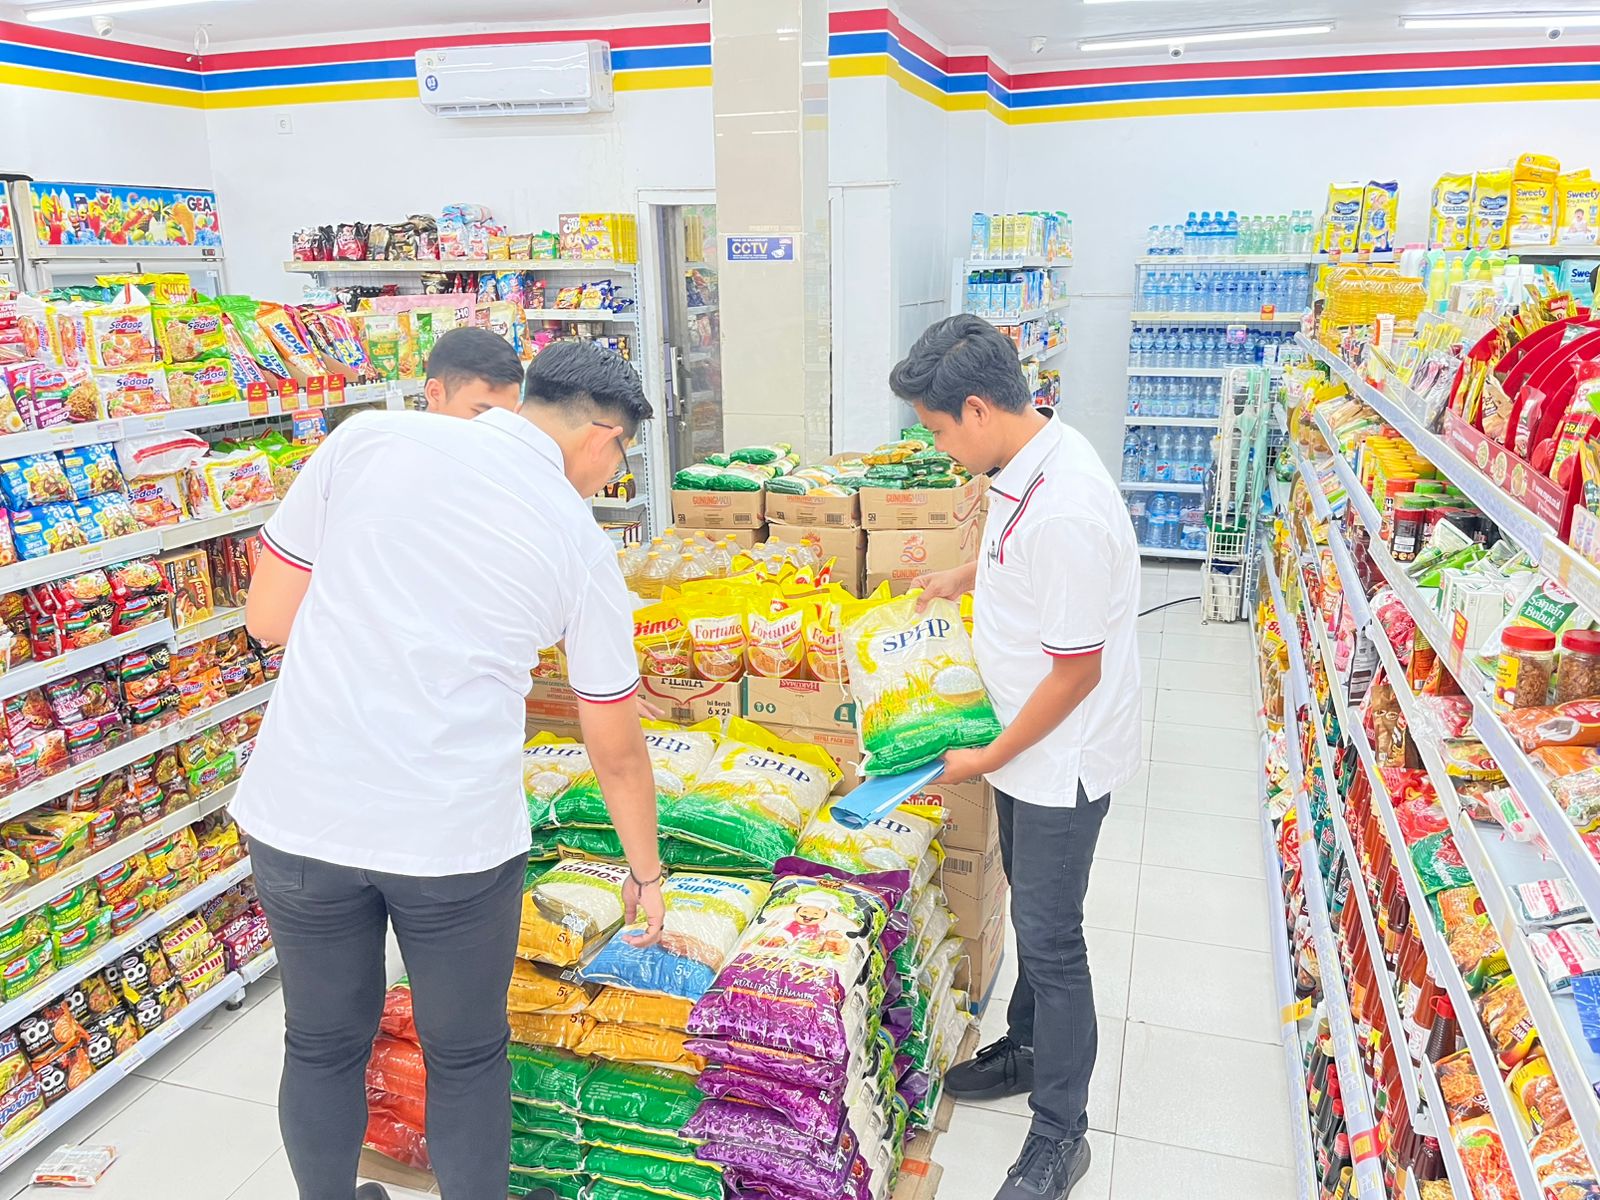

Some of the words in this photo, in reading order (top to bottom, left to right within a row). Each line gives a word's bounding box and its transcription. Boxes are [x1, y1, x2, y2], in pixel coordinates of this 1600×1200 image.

[1516, 187, 1547, 199] Sweety
[1566, 189, 1600, 201] Sweety
[186, 196, 212, 212] GEA
[731, 242, 768, 254] CCTV
[1571, 268, 1591, 279] Swe
[110, 320, 142, 331] Sedaap
[187, 319, 219, 331] Sedaap
[273, 322, 309, 355] WOW
[115, 377, 154, 388] Sedaap
[194, 370, 229, 382] Sedaap
[127, 486, 163, 501] Sedaap
[189, 571, 208, 605] Tasty
[1527, 593, 1565, 620] Santan
[1525, 605, 1557, 628] Bubuk
[634, 617, 684, 637] Bimo
[695, 624, 742, 639] Fortune
[750, 620, 797, 641] Fortune
[883, 618, 951, 653] SPHP
[812, 627, 841, 646] Fort
[707, 707, 714, 715] 6
[911, 702, 921, 714] 5
[645, 736, 691, 752] PHP
[745, 754, 812, 784] SPHP
[905, 796, 940, 806] SunCo
[875, 817, 912, 835] HP
[556, 864, 623, 884] Ramos
[672, 882, 723, 895] Super
[703, 877, 752, 896] Kepala
[163, 918, 205, 950] sarimi
[234, 922, 270, 961] Sukses
[180, 952, 224, 983] sarimi
[20, 1021, 50, 1044] 100
